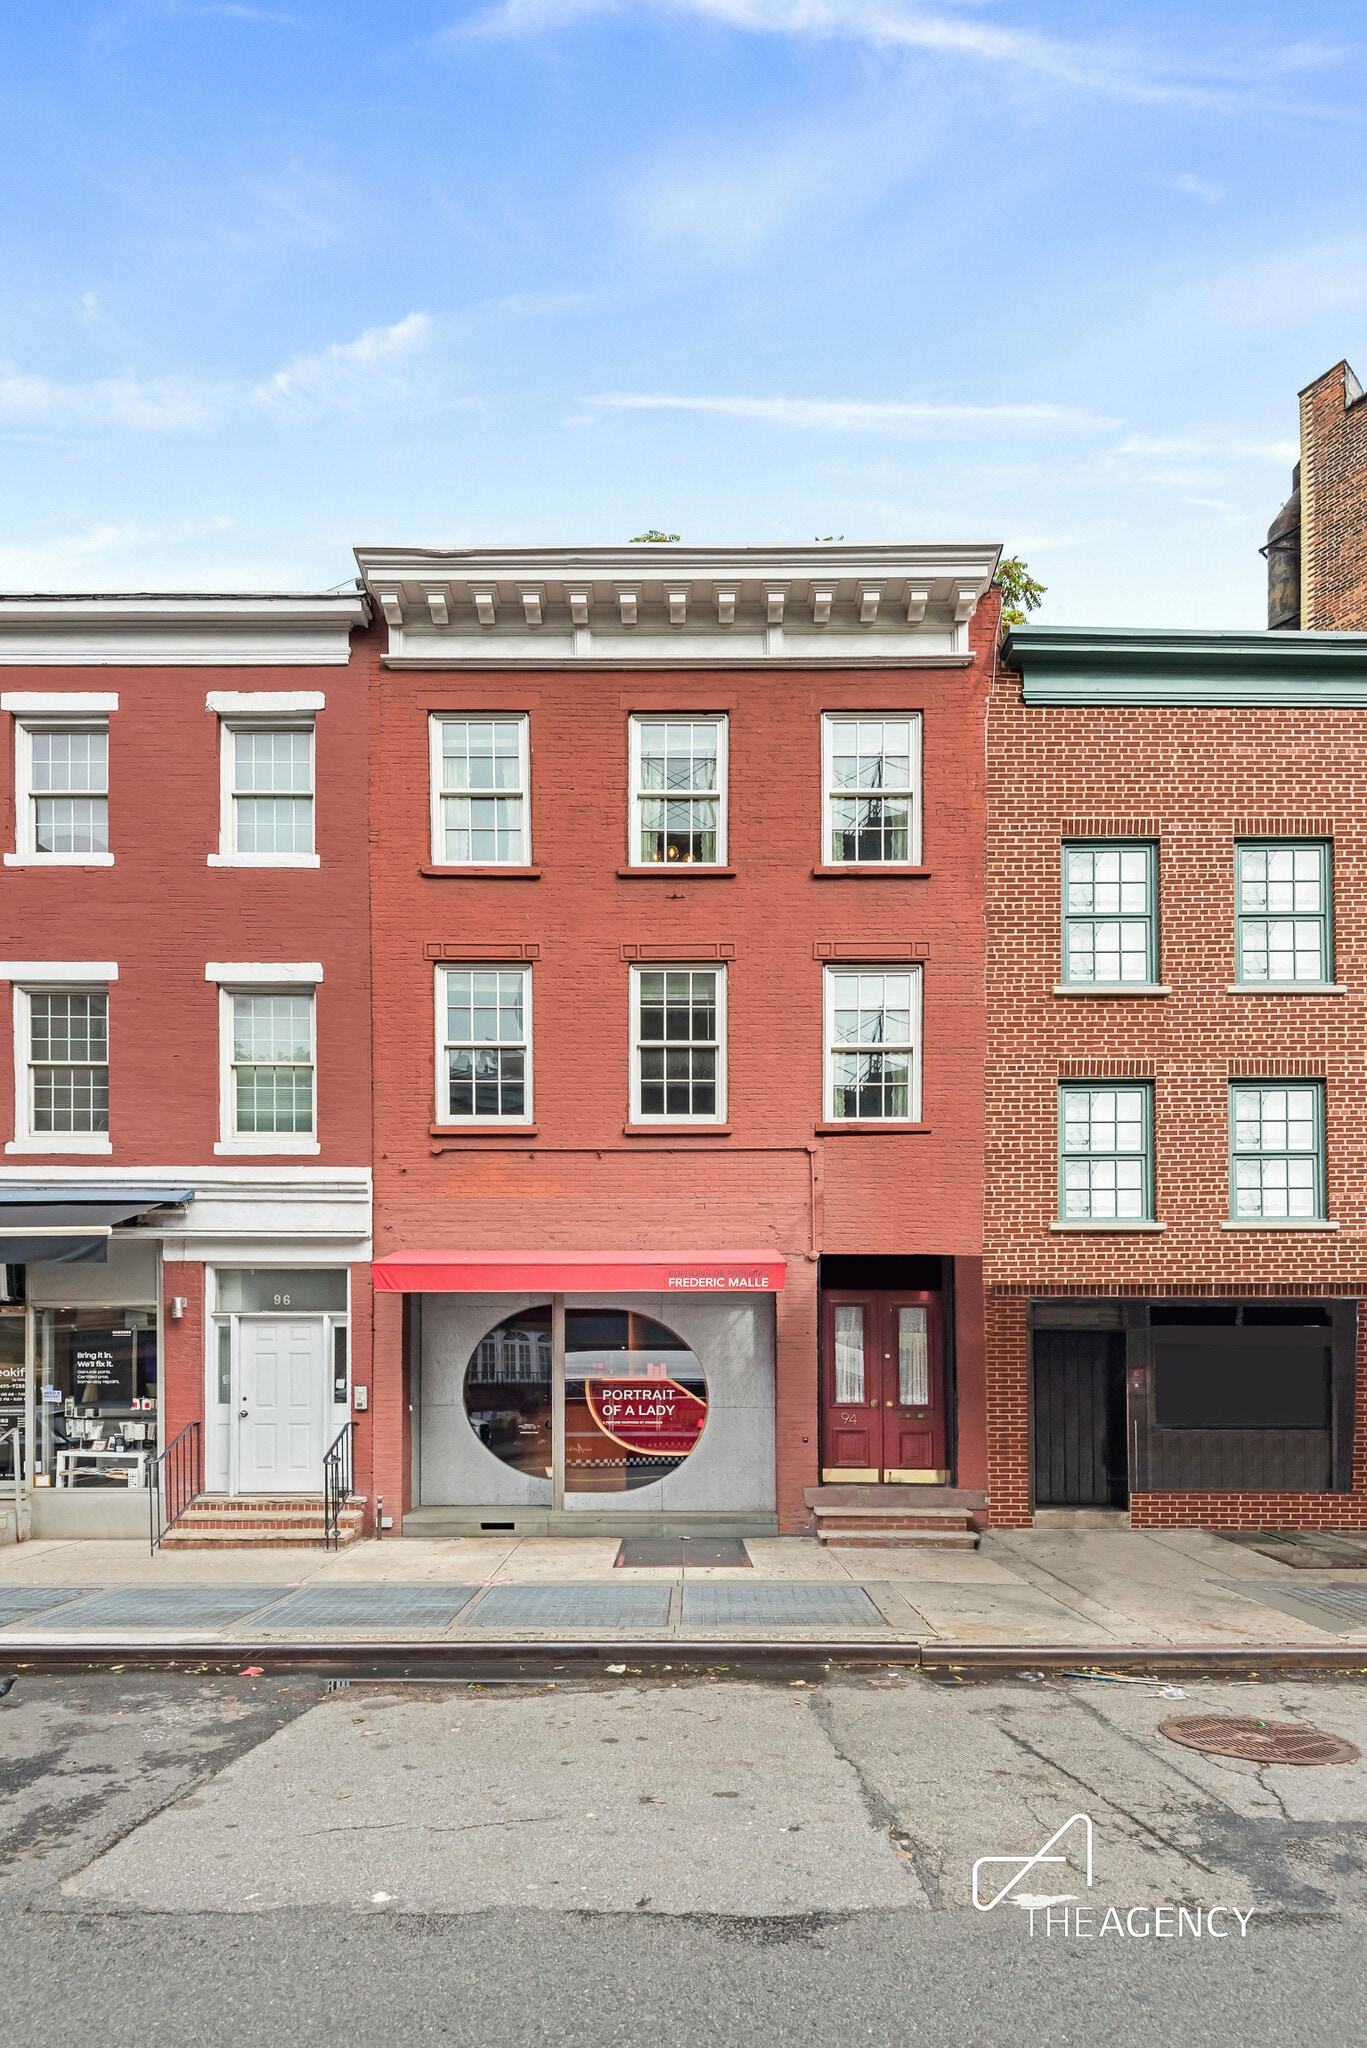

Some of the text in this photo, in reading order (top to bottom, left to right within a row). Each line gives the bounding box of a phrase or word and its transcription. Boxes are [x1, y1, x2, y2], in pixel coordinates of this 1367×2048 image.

[668, 1269, 711, 1277] EDITIONS
[713, 1269, 725, 1277] DE
[668, 1277, 769, 1287] FREDERIC MALLE
[273, 1294, 291, 1306] 96
[77, 1352, 97, 1360] Bring
[602, 1389, 676, 1400] PORTRAIT
[602, 1405, 675, 1415] OF A LADY
[841, 1412, 857, 1425] 94
